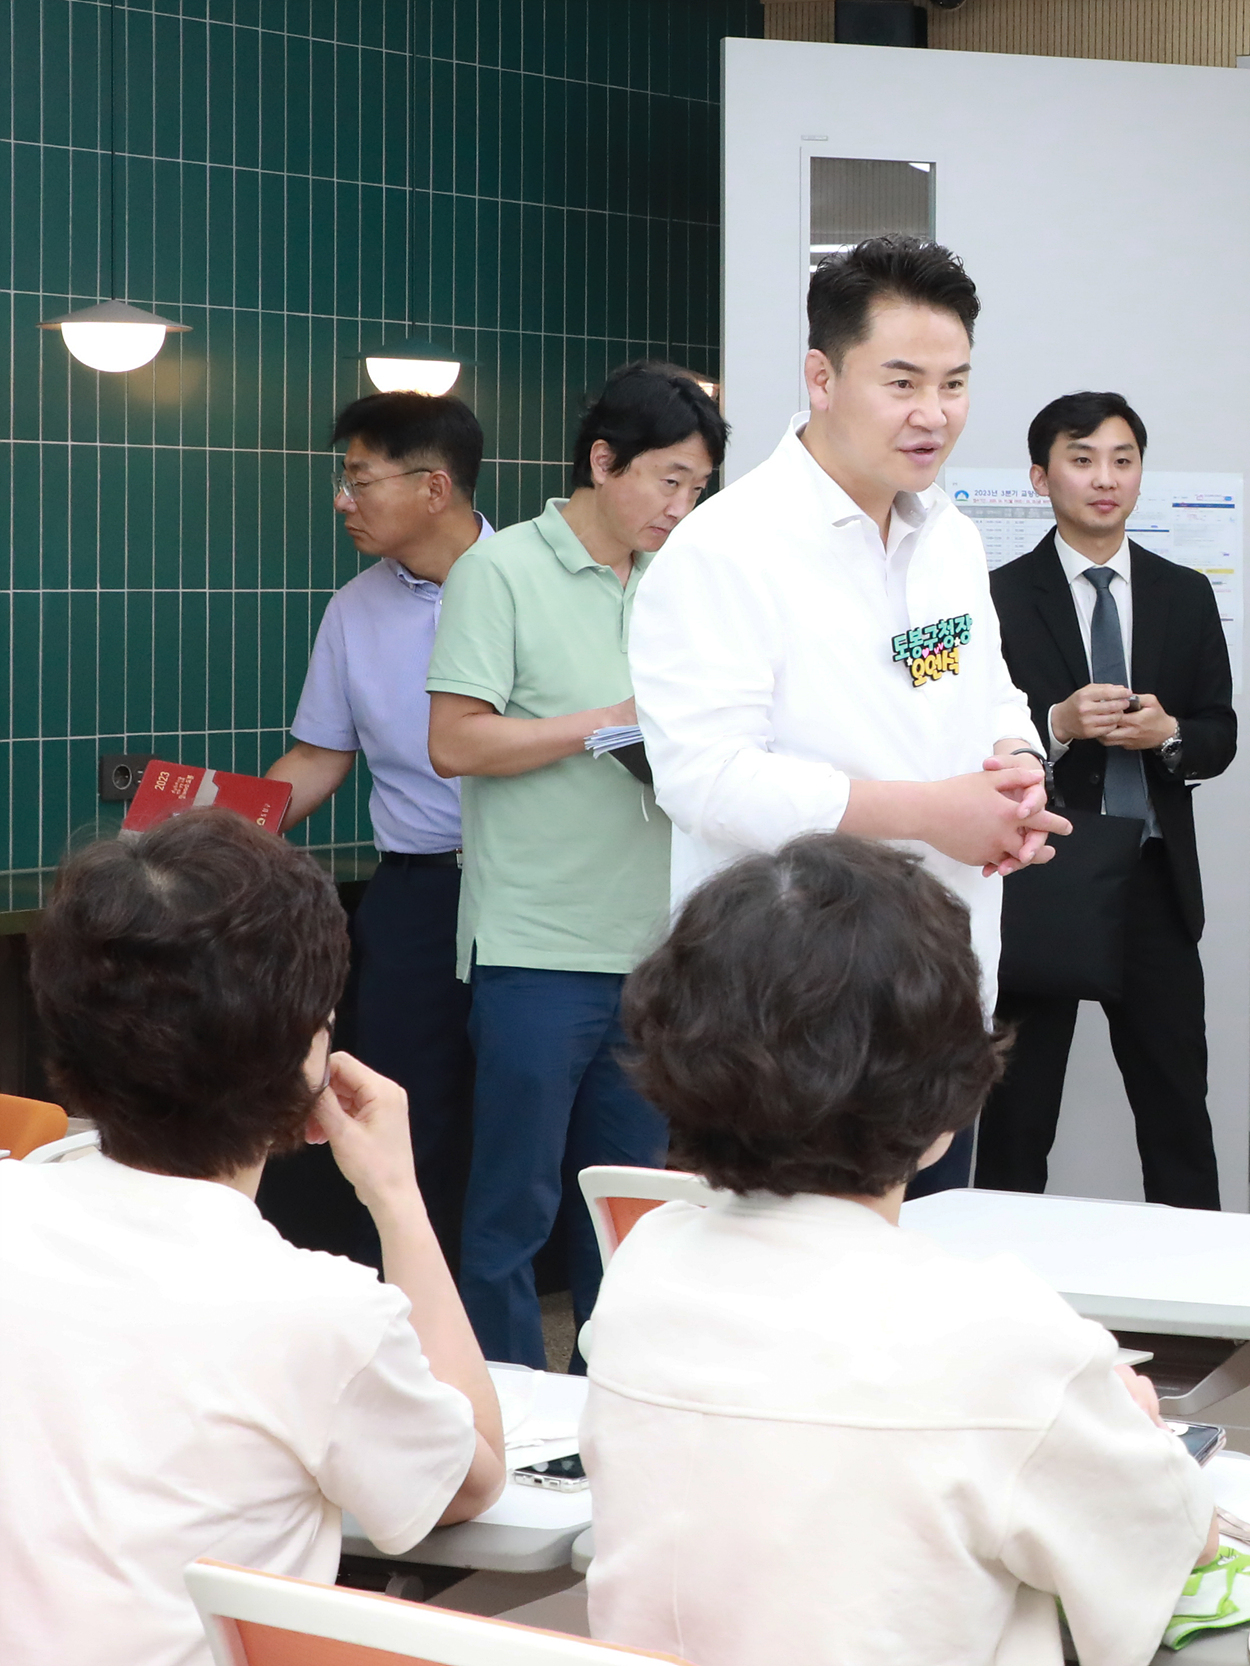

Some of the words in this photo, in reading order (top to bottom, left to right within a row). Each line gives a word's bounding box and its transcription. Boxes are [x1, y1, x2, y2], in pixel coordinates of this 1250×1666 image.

[974, 489, 998, 497] 2023년
[892, 613, 973, 662] 도봉구청장
[154, 771, 171, 791] 2023
